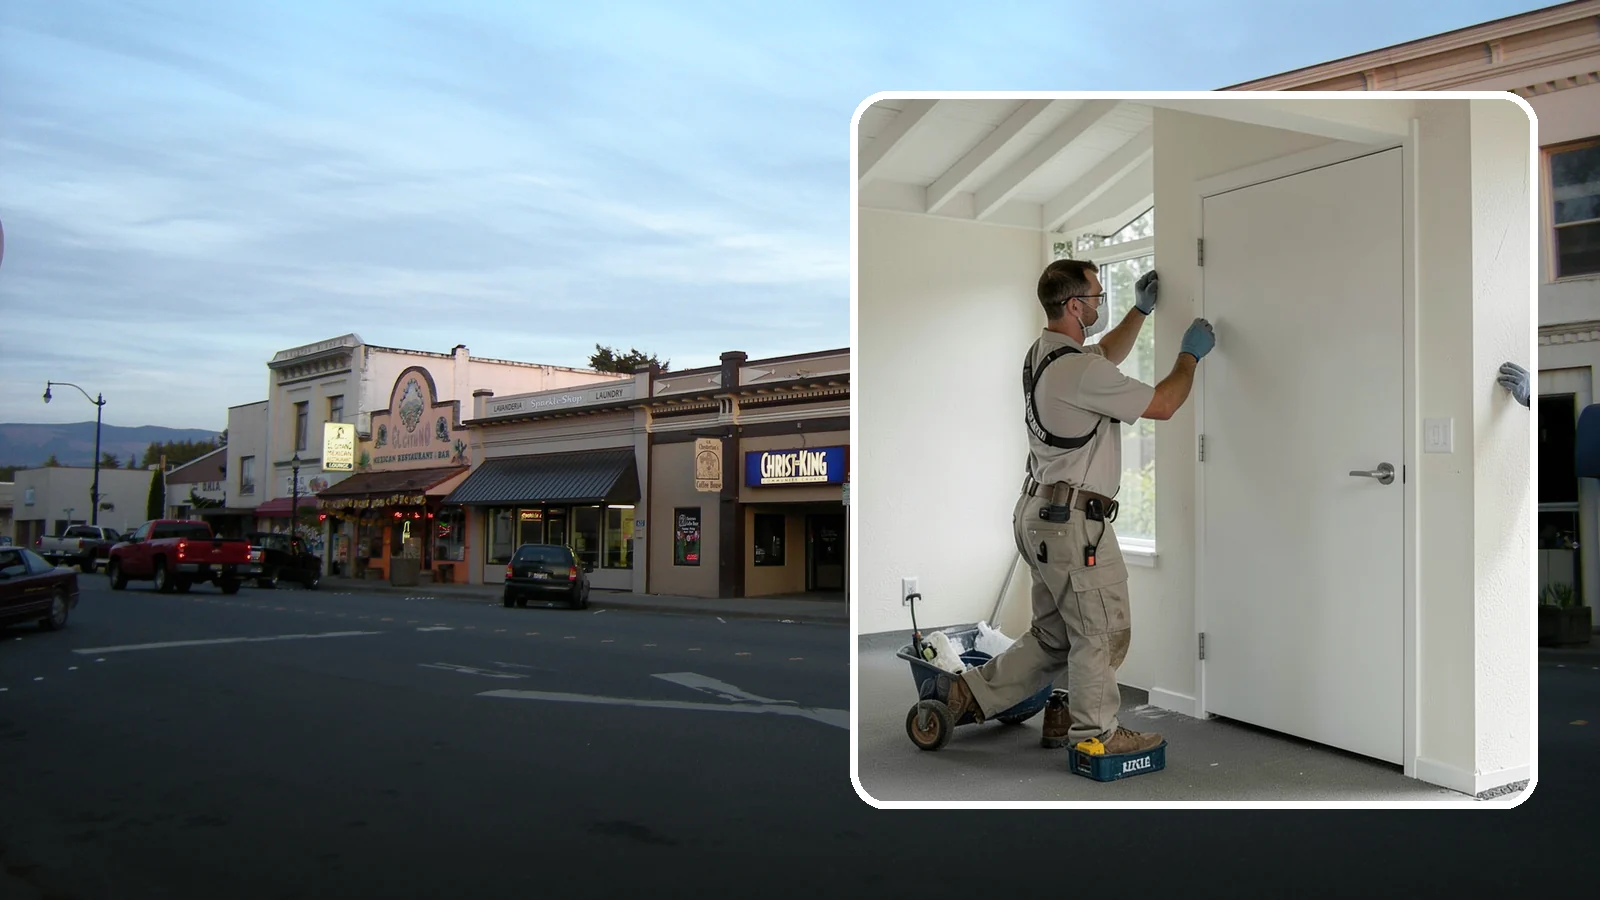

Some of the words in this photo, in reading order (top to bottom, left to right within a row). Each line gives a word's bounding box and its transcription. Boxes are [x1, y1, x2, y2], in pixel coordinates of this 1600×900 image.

[494, 401, 522, 412] LAVANDERIA
[562, 394, 582, 405] Shop
[596, 389, 623, 400] LAUNDRY
[398, 451, 433, 462] RESTAURANT
[438, 450, 450, 459] BAR
[761, 452, 796, 477] CHRIST
[799, 450, 827, 476] KING
